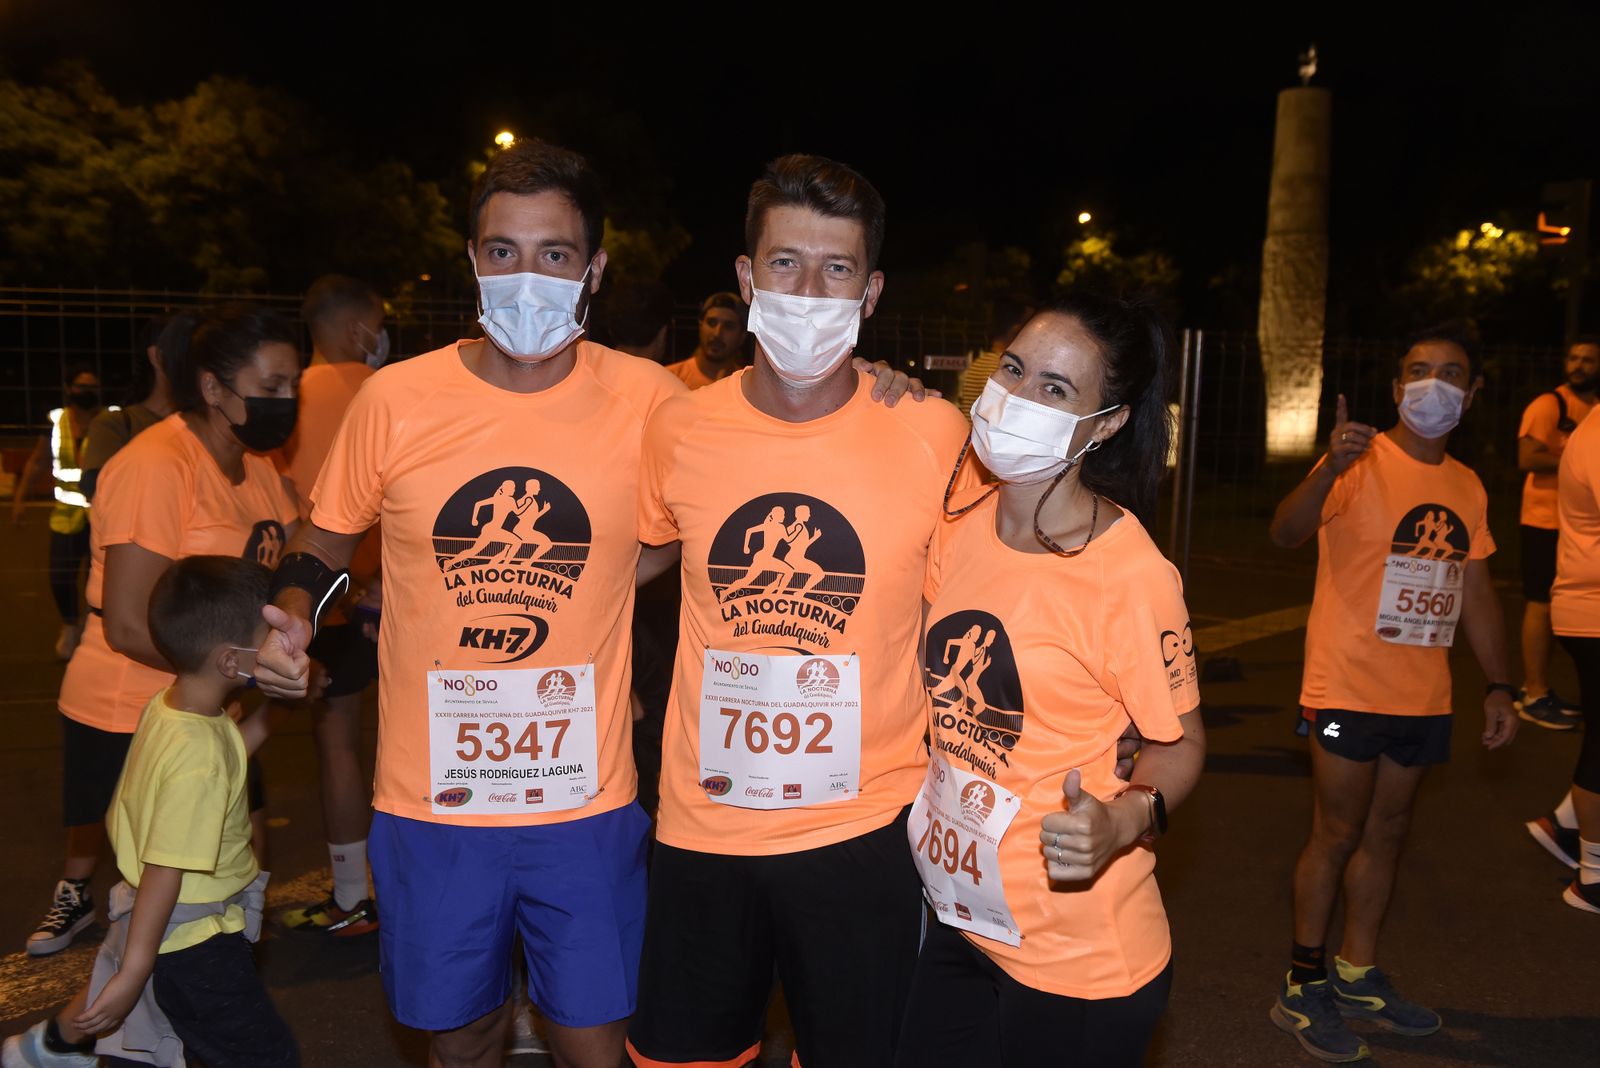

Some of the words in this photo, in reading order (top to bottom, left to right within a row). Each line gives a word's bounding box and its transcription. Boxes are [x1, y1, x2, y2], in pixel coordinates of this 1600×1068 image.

[444, 573, 467, 591] LA
[470, 568, 574, 599] NOCTURNA
[456, 590, 475, 607] del
[476, 588, 558, 613] Guadalquivir
[1396, 588, 1455, 617] 5560
[721, 604, 742, 622] LA
[746, 598, 847, 634] NOCTURNA
[1379, 614, 1402, 623] MIGUEL
[733, 621, 749, 637] del
[751, 618, 831, 648] Guadalquivir
[524, 708, 568, 718] GUADALQUIVIR
[718, 696, 741, 704] CARRERA
[741, 699, 770, 708] NOCTURNA
[455, 718, 571, 762] 5347
[719, 707, 833, 755] 7692
[444, 766, 477, 779] JESÚS
[479, 766, 539, 779] RODRÍGUEZ
[542, 763, 584, 778] LAGUNA
[916, 809, 983, 886] 7694
